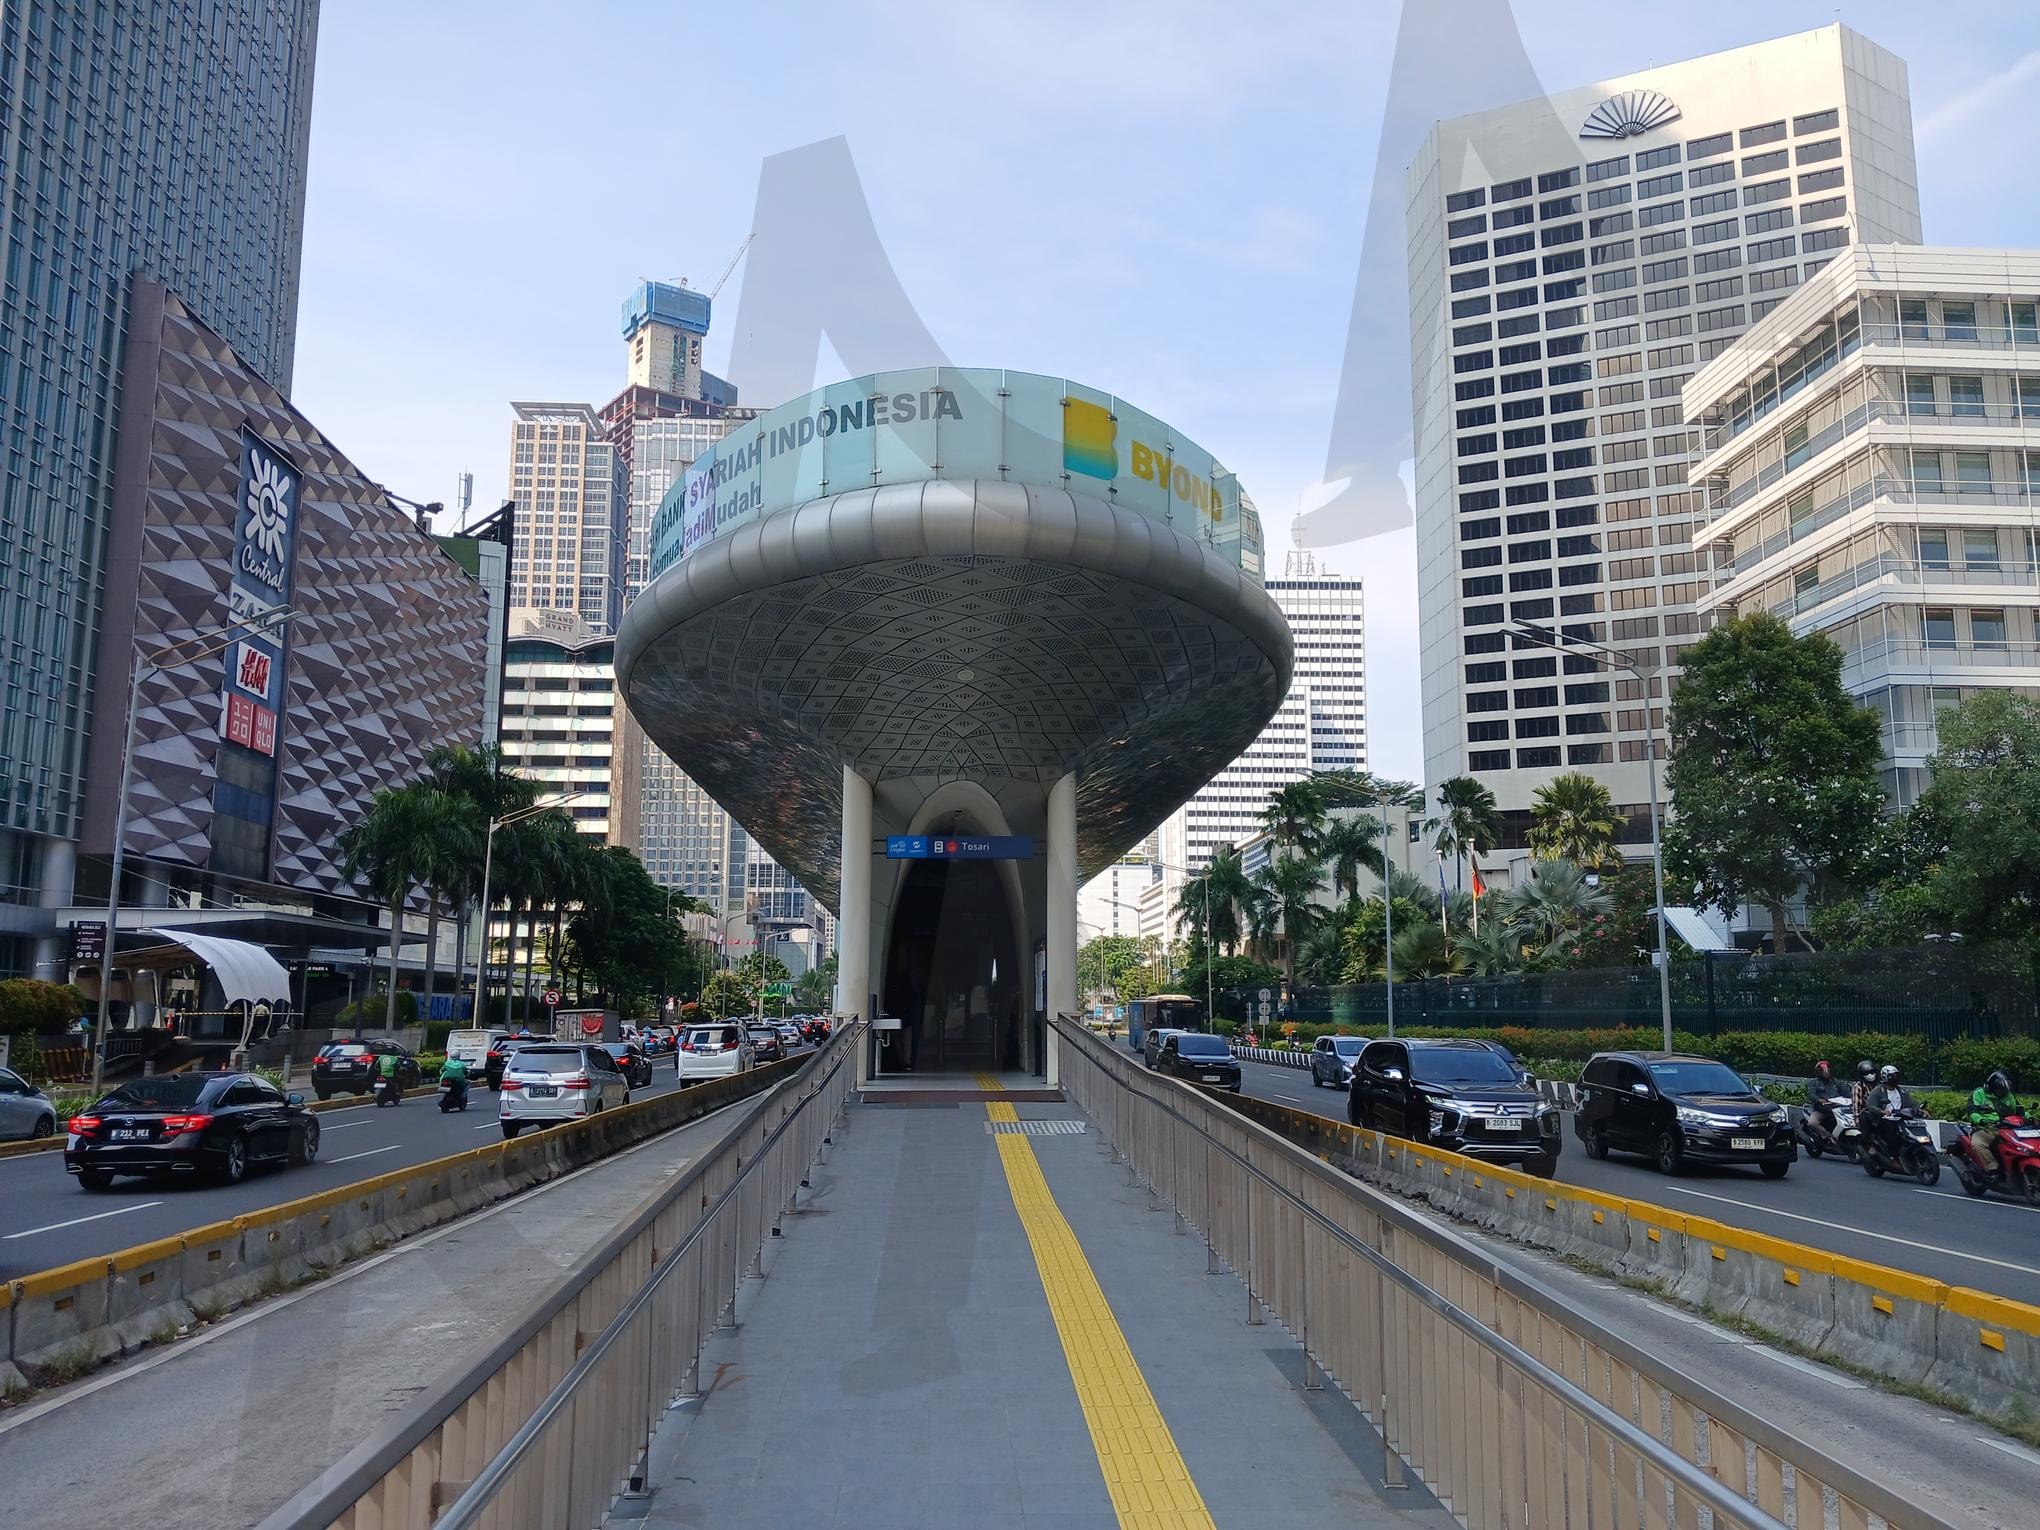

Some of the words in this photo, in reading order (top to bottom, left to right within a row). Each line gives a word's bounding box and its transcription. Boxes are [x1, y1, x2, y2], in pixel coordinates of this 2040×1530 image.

[690, 437, 761, 507] SYARIAH
[770, 391, 963, 459] INDONESIA
[1132, 440, 1222, 522] BYOND
[242, 544, 284, 592] Central
[546, 614, 574, 624] GRAND
[546, 622, 572, 632] HYATT
[257, 711, 272, 731] UNI
[256, 730, 272, 749] QLO
[961, 842, 990, 851] Tosari
